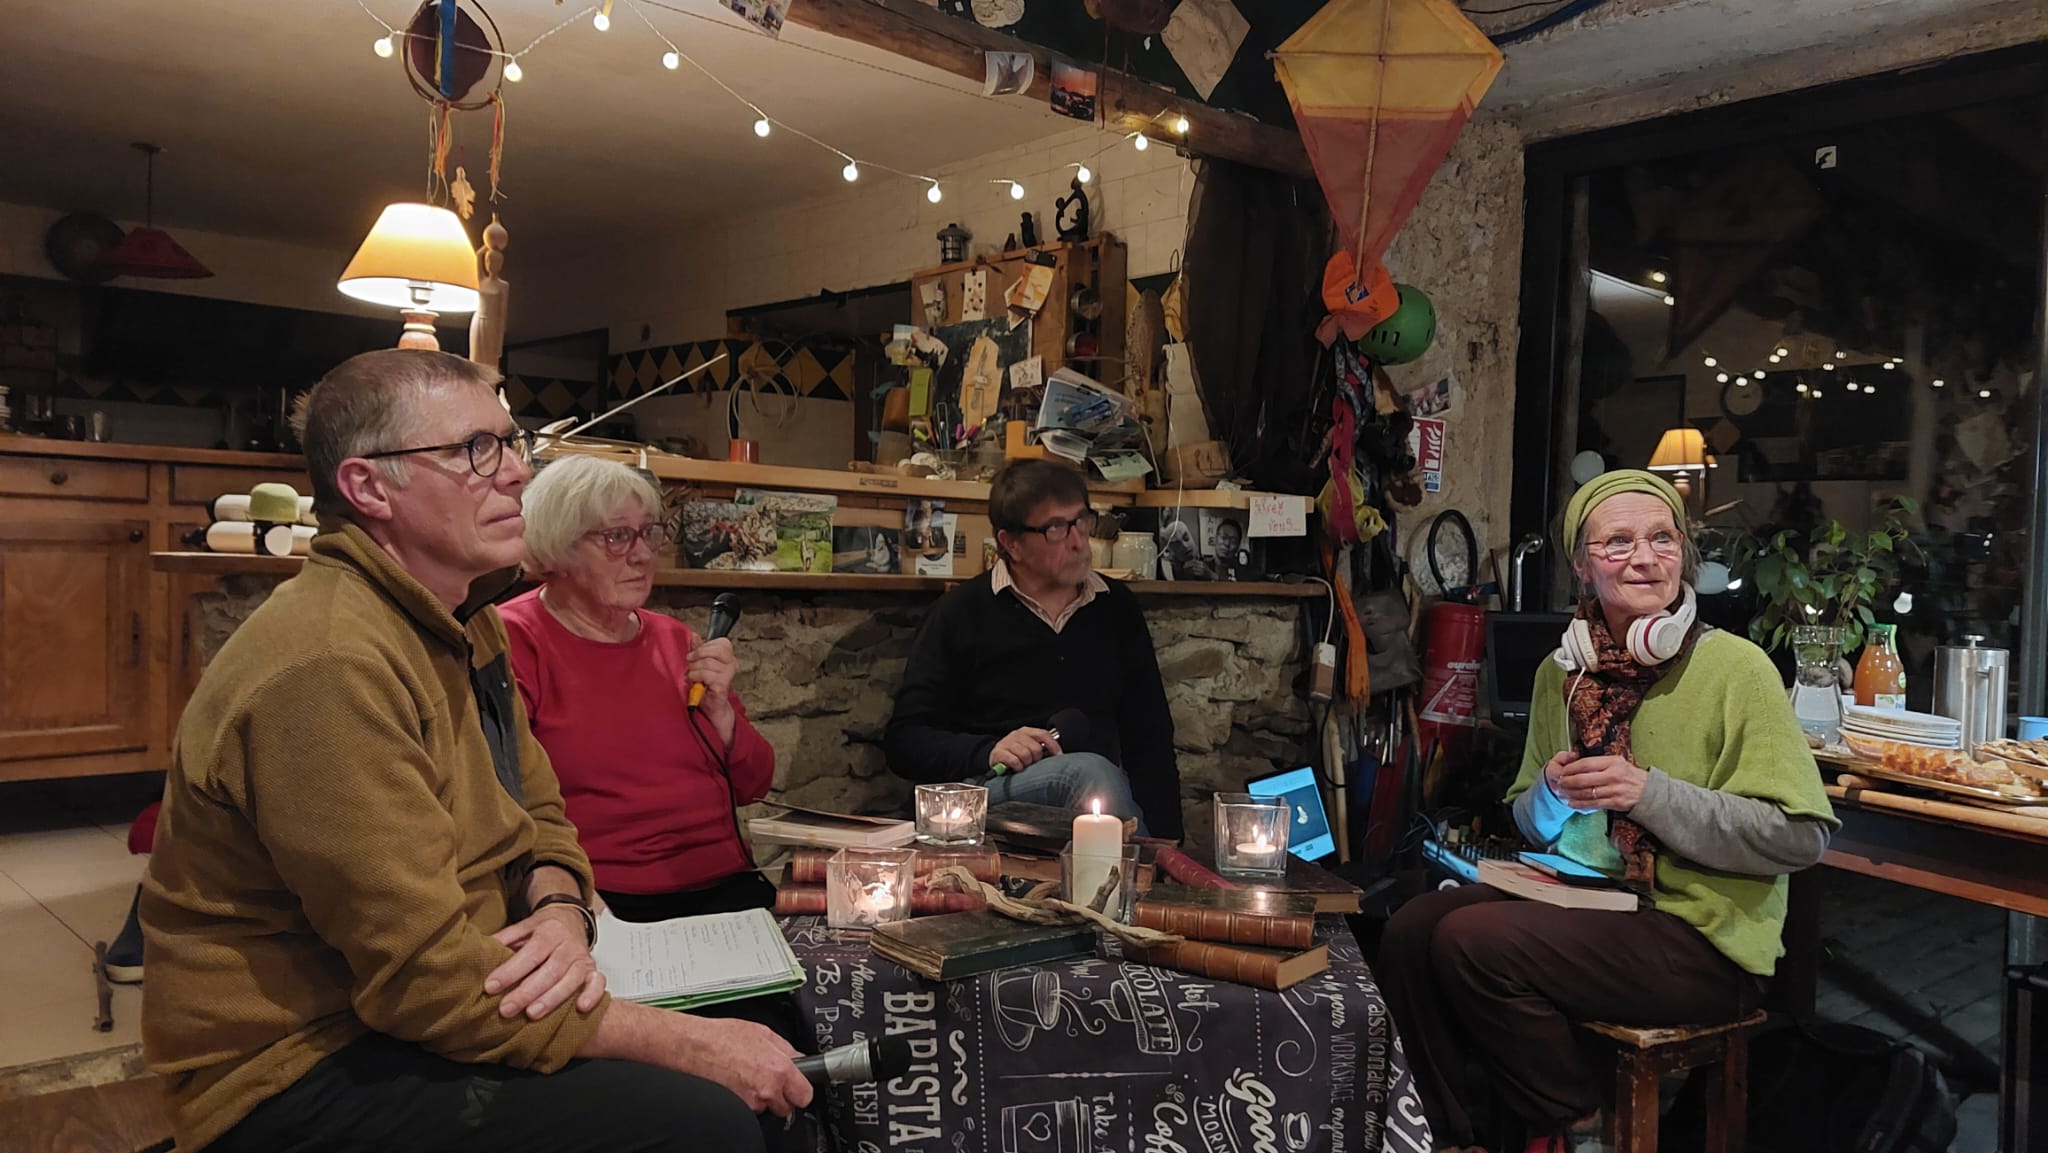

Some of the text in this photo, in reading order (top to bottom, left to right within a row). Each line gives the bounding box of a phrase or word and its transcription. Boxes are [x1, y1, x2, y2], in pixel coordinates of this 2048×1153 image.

[1125, 964, 1174, 1050] OCOLATE
[1329, 1032, 1357, 1104] WORKSPACE
[852, 1080, 879, 1126] RESH
[1093, 1091, 1118, 1140] Take
